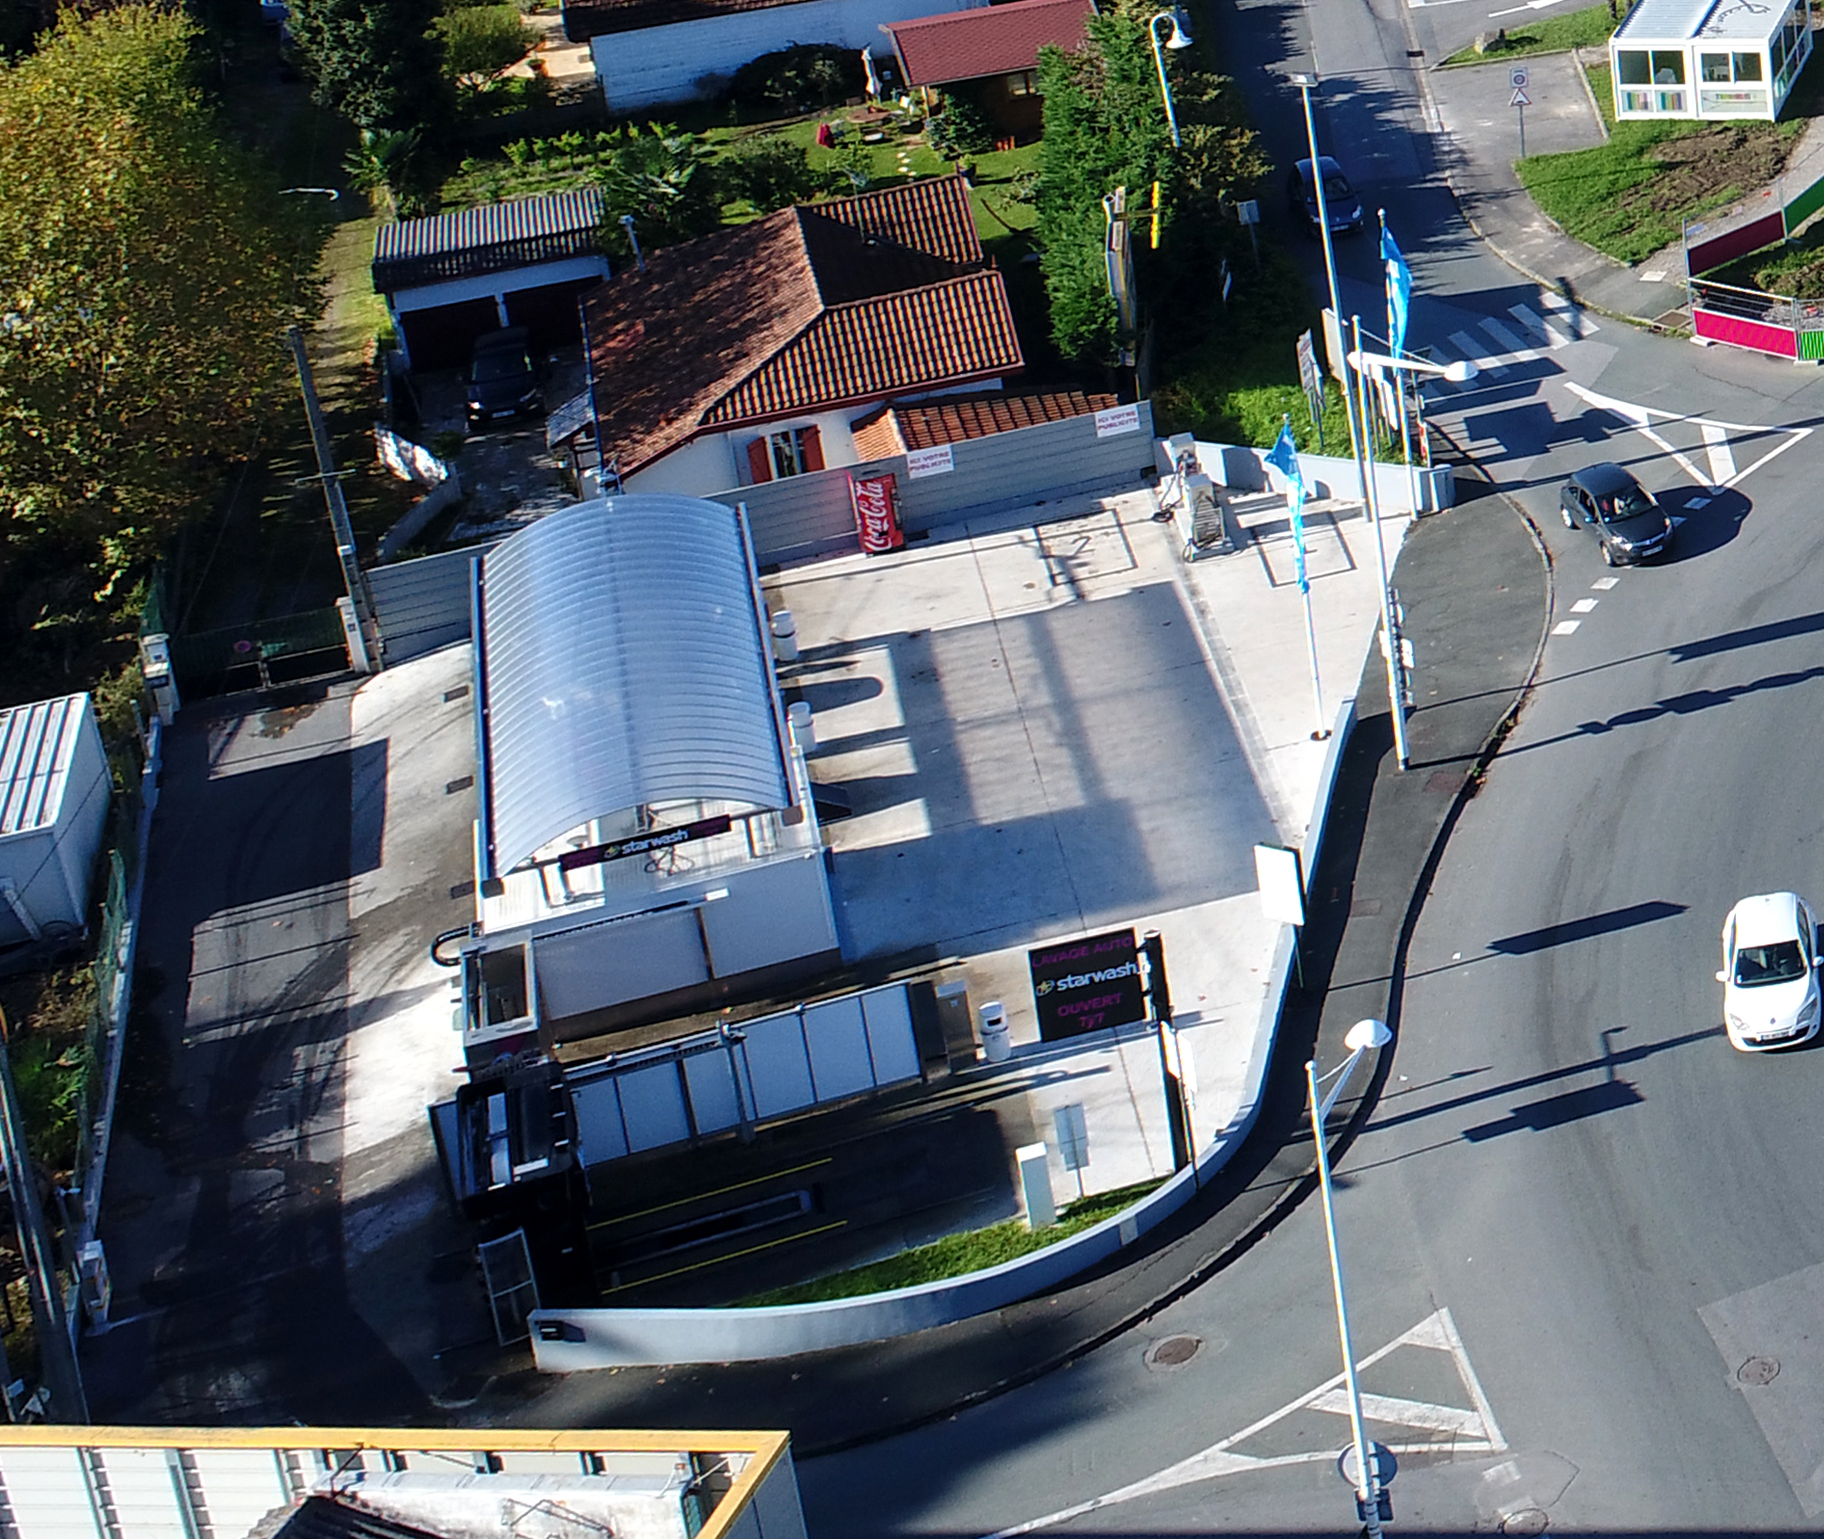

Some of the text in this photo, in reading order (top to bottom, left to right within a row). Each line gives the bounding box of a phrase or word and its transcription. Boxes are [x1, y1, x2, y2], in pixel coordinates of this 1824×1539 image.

[621, 828, 690, 855] starwash
[1032, 936, 1133, 968] LAVAGE AUTO
[1056, 961, 1138, 992] starwash
[1058, 992, 1123, 1017] OUVERT
